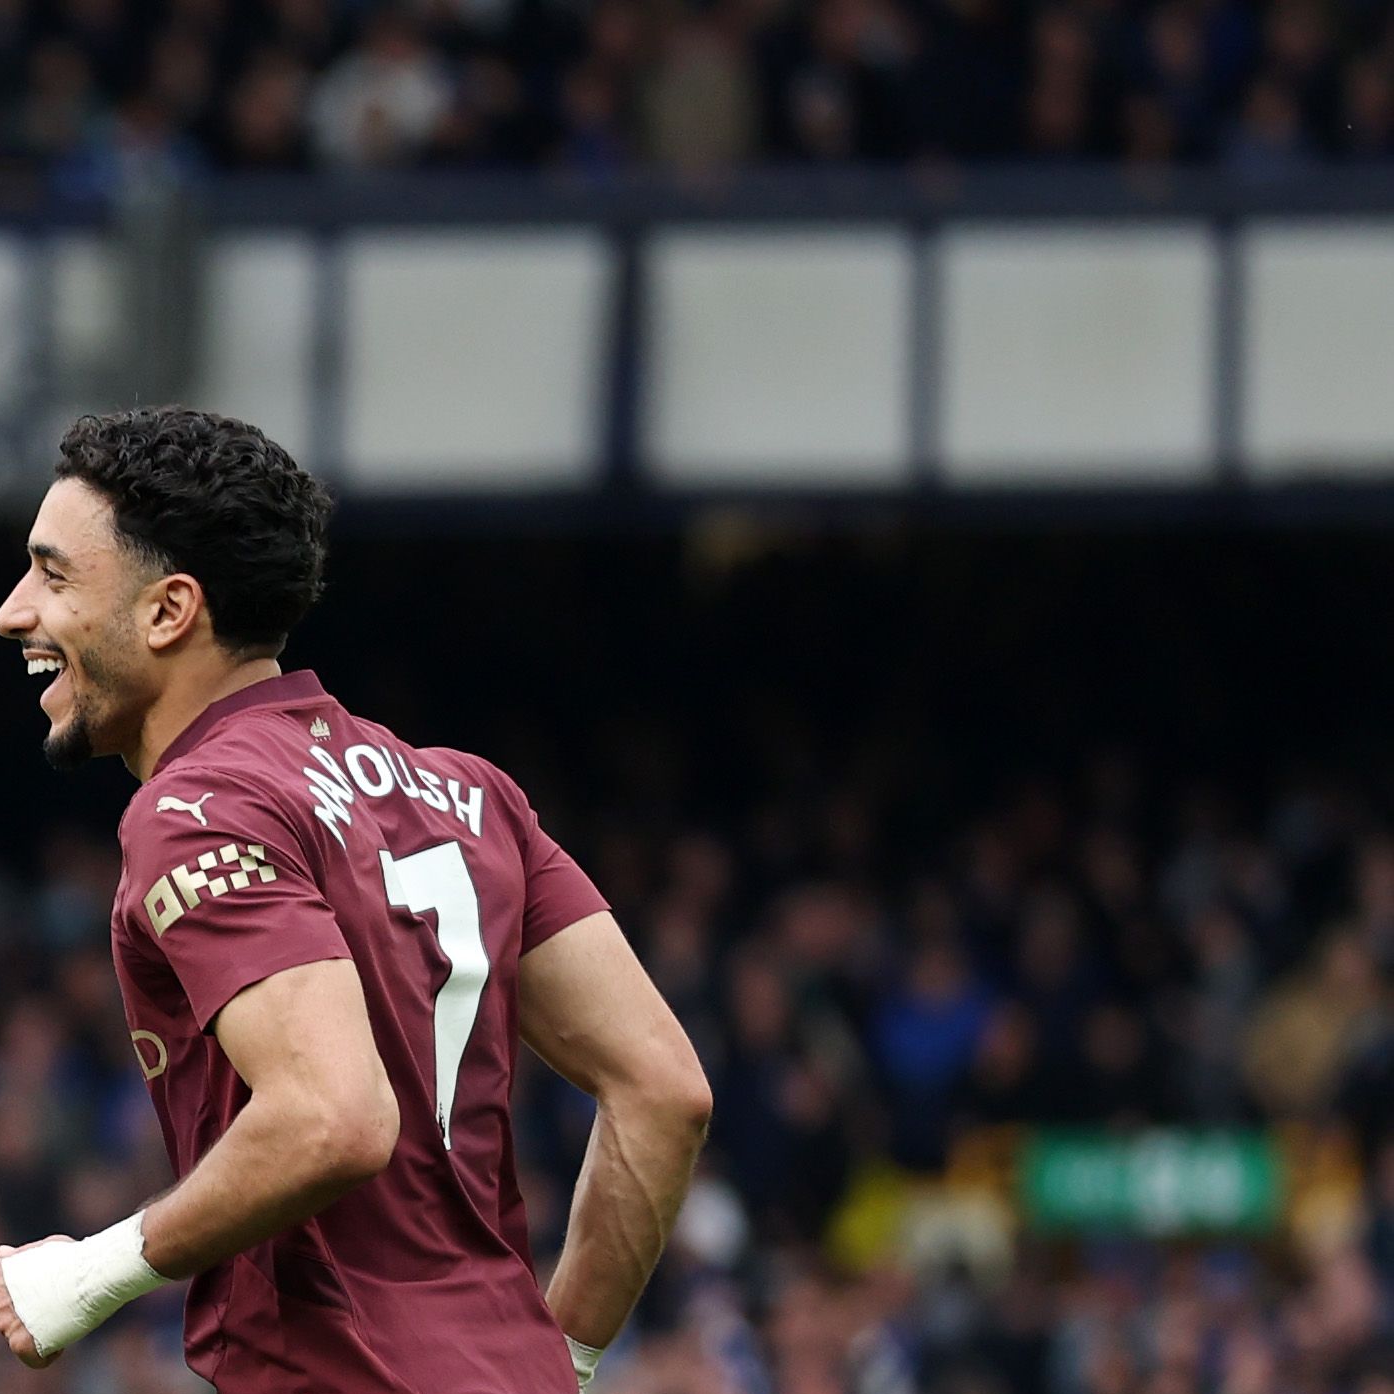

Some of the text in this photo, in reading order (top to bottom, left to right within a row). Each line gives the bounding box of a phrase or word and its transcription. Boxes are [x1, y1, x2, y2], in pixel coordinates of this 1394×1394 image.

[303, 744, 484, 851] MAROUSH
[142, 843, 277, 939] OKX
[378, 840, 491, 1152] 7
